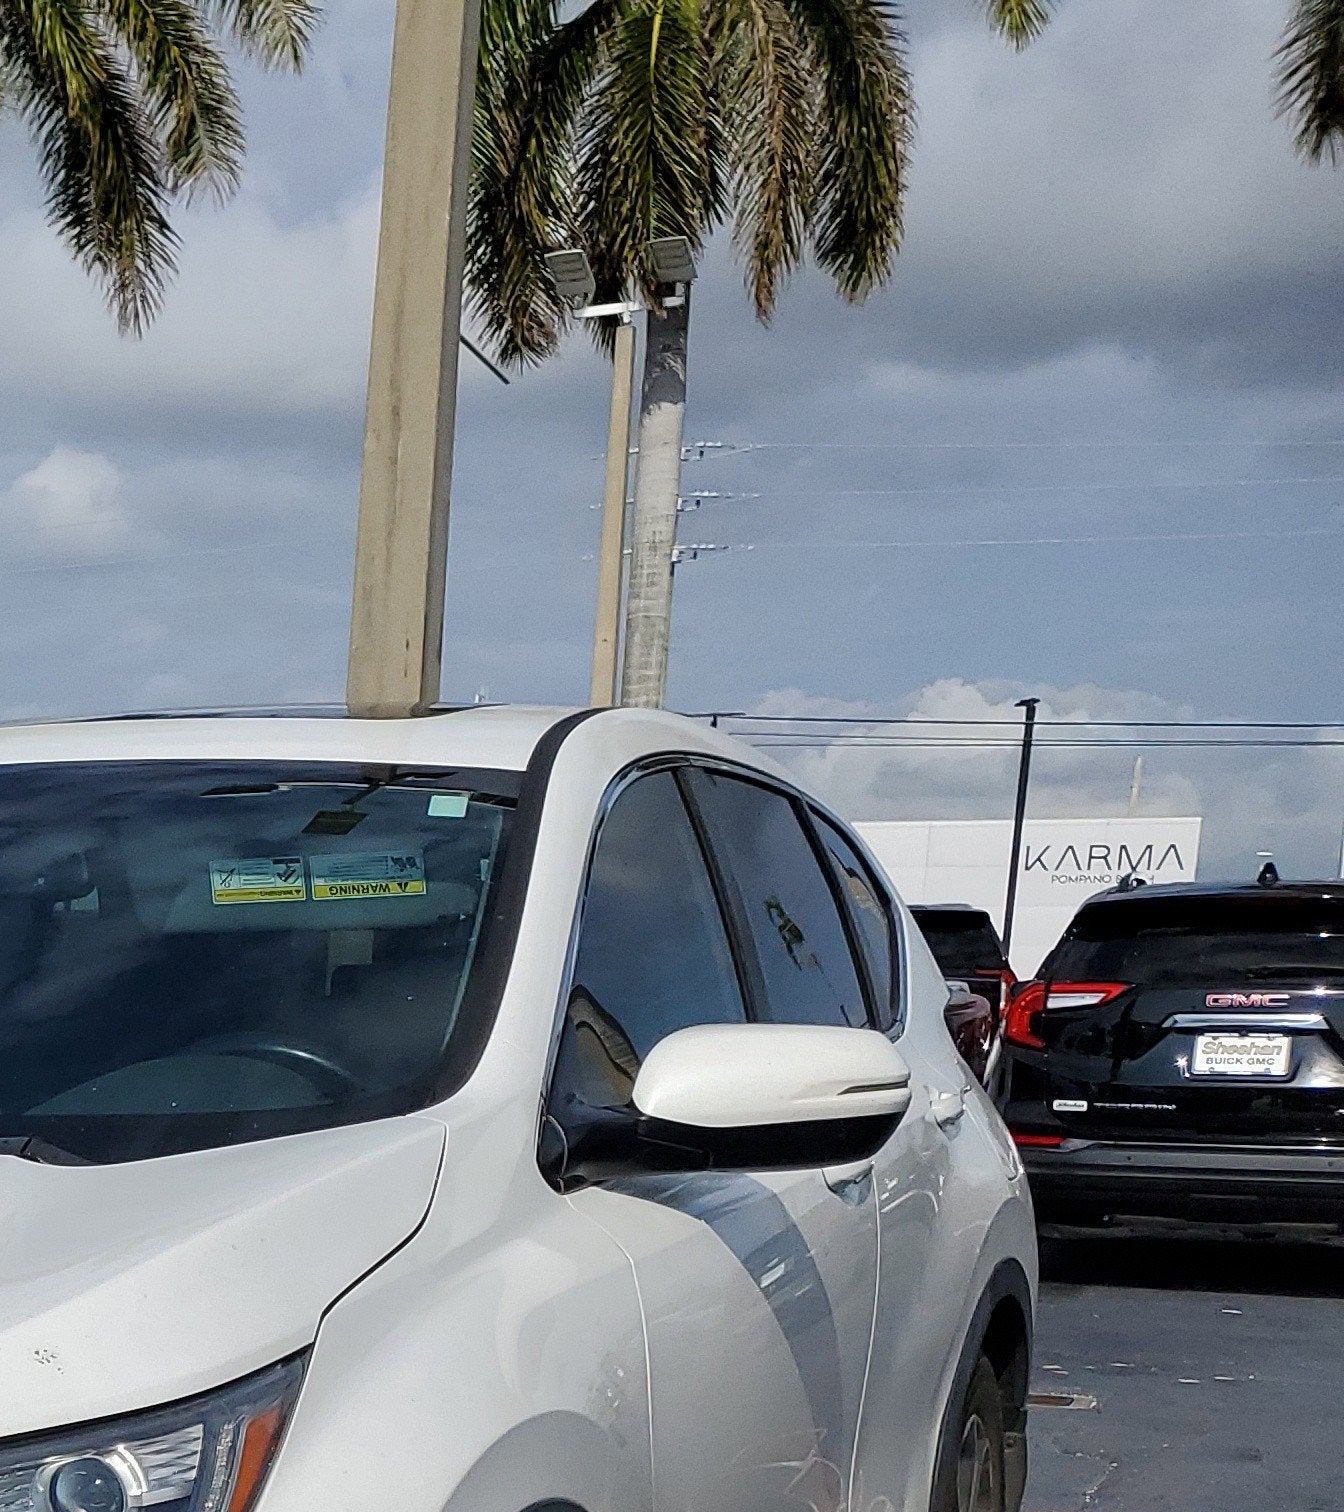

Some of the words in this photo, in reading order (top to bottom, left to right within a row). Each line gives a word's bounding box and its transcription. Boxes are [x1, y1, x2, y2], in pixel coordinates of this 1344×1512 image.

[1025, 843, 1184, 871] KARMA
[1051, 874, 1112, 885] POMPANO
[328, 883, 391, 896] WARNING
[1205, 993, 1290, 1008] GMC
[1202, 1041, 1283, 1056] Sheehan
[1206, 1057, 1243, 1066] BUICK
[1247, 1057, 1275, 1066] GMC
